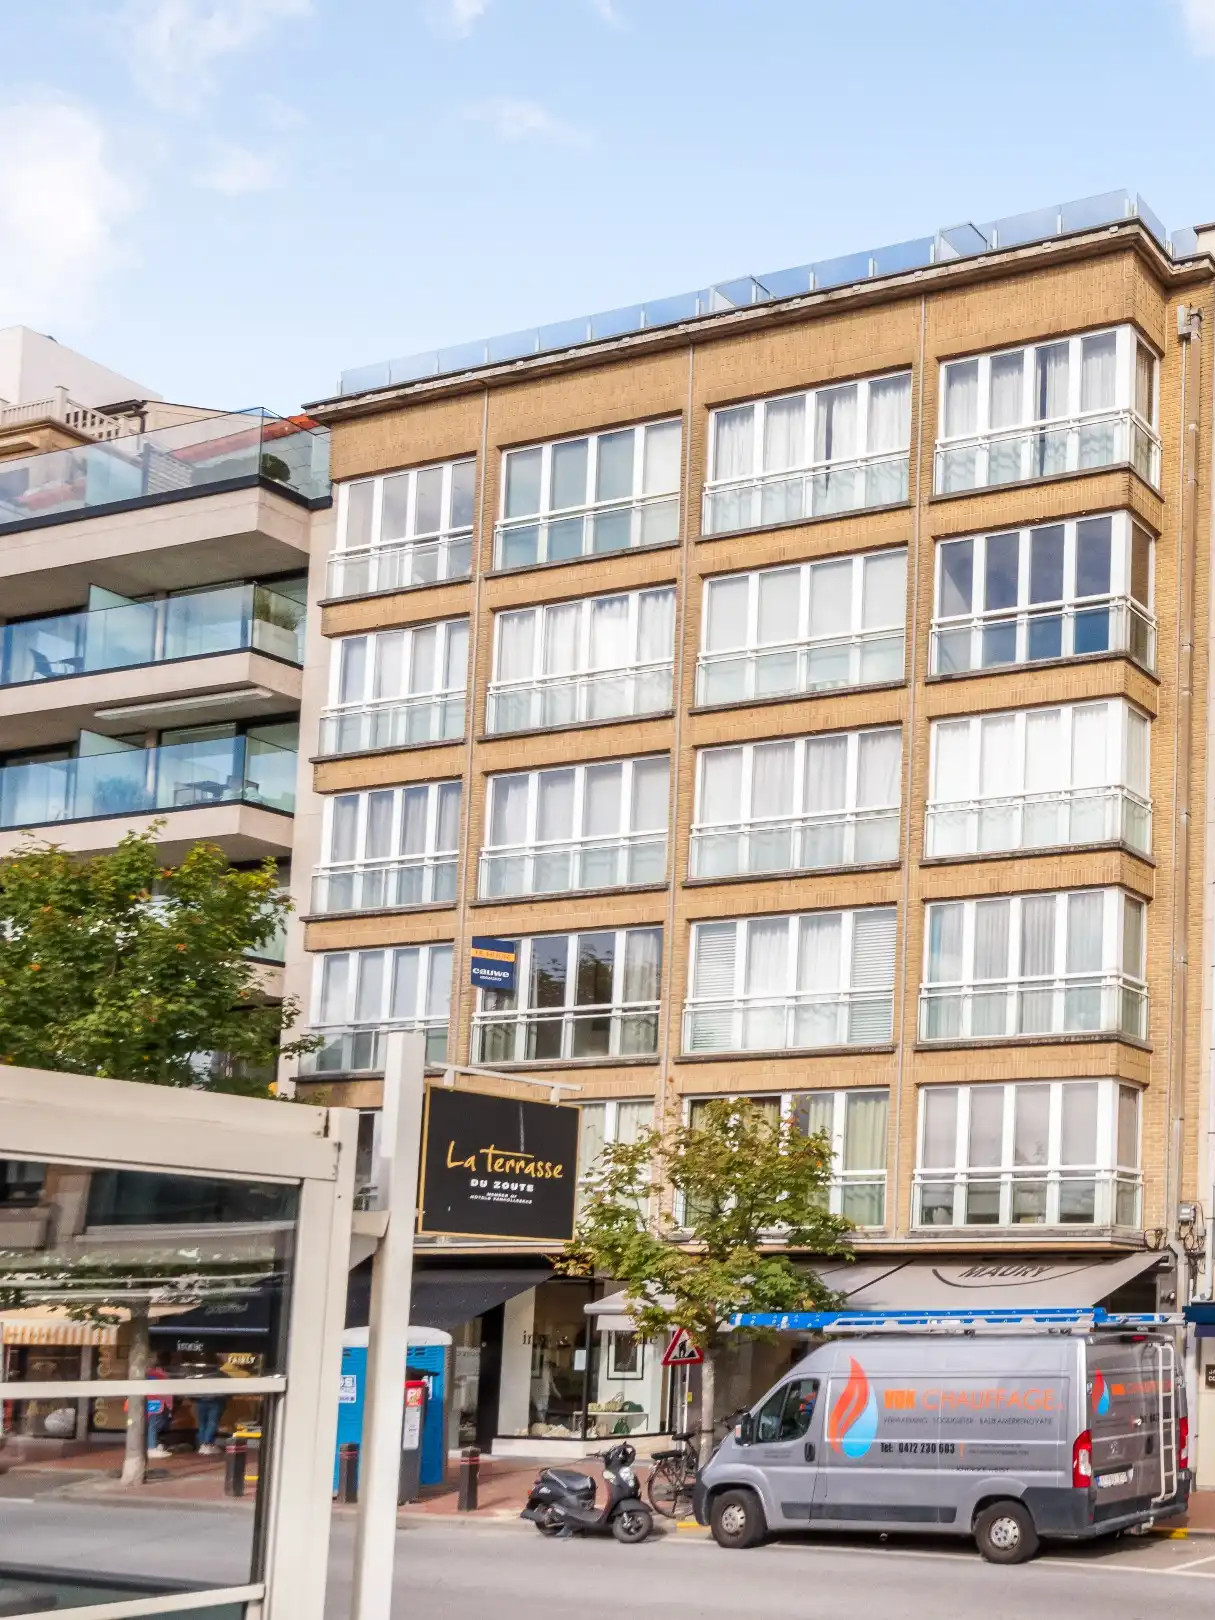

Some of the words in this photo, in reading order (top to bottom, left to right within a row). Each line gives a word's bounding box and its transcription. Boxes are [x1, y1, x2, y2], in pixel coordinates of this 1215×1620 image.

[472, 967, 510, 978] cauwe
[446, 1140, 476, 1172] La
[479, 1143, 564, 1179] terrasse
[470, 1178, 488, 1188] DU
[493, 1180, 534, 1192] ZOUTE
[957, 1263, 1056, 1278] MAURY
[921, 1388, 1057, 1412] CHAUFFAGE
[898, 1442, 918, 1454] 0472
